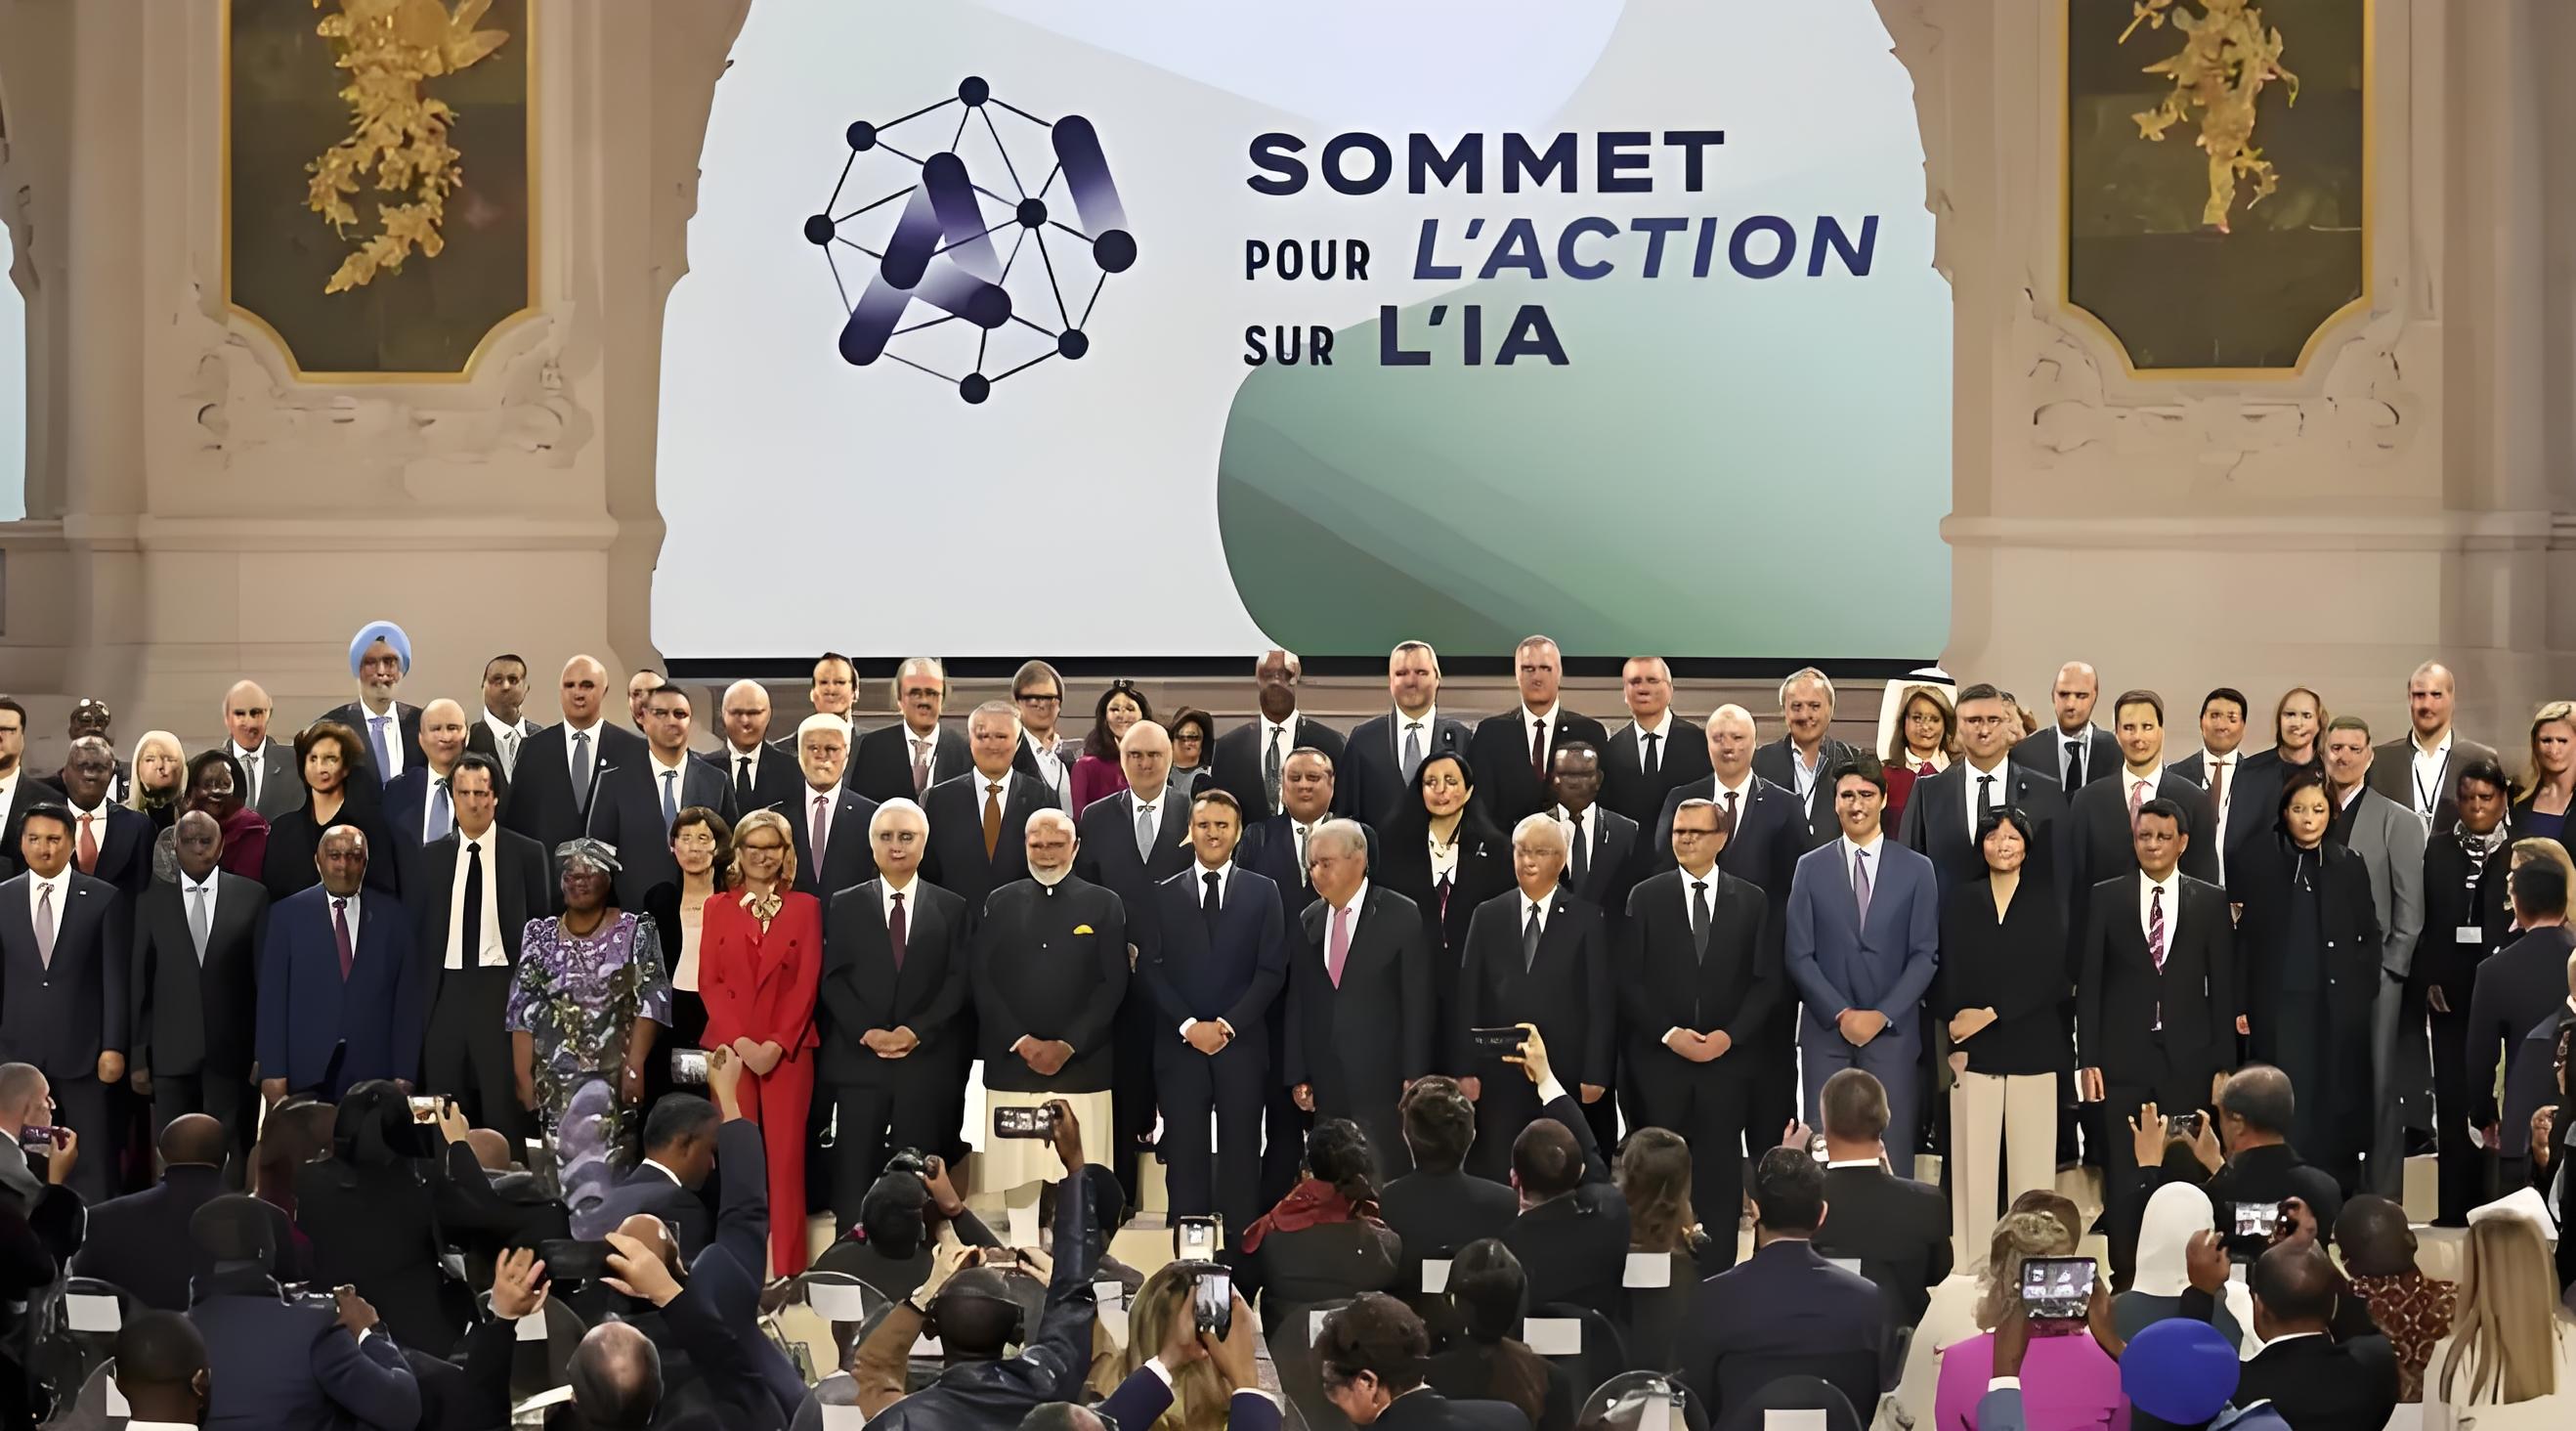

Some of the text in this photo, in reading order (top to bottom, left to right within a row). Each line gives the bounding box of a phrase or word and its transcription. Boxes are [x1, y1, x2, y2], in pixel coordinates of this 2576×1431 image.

[1246, 130, 1725, 196] SOMMET
[1245, 215, 1879, 282] POUR L'ACTION
[1243, 304, 1570, 367] SUR L'IA
